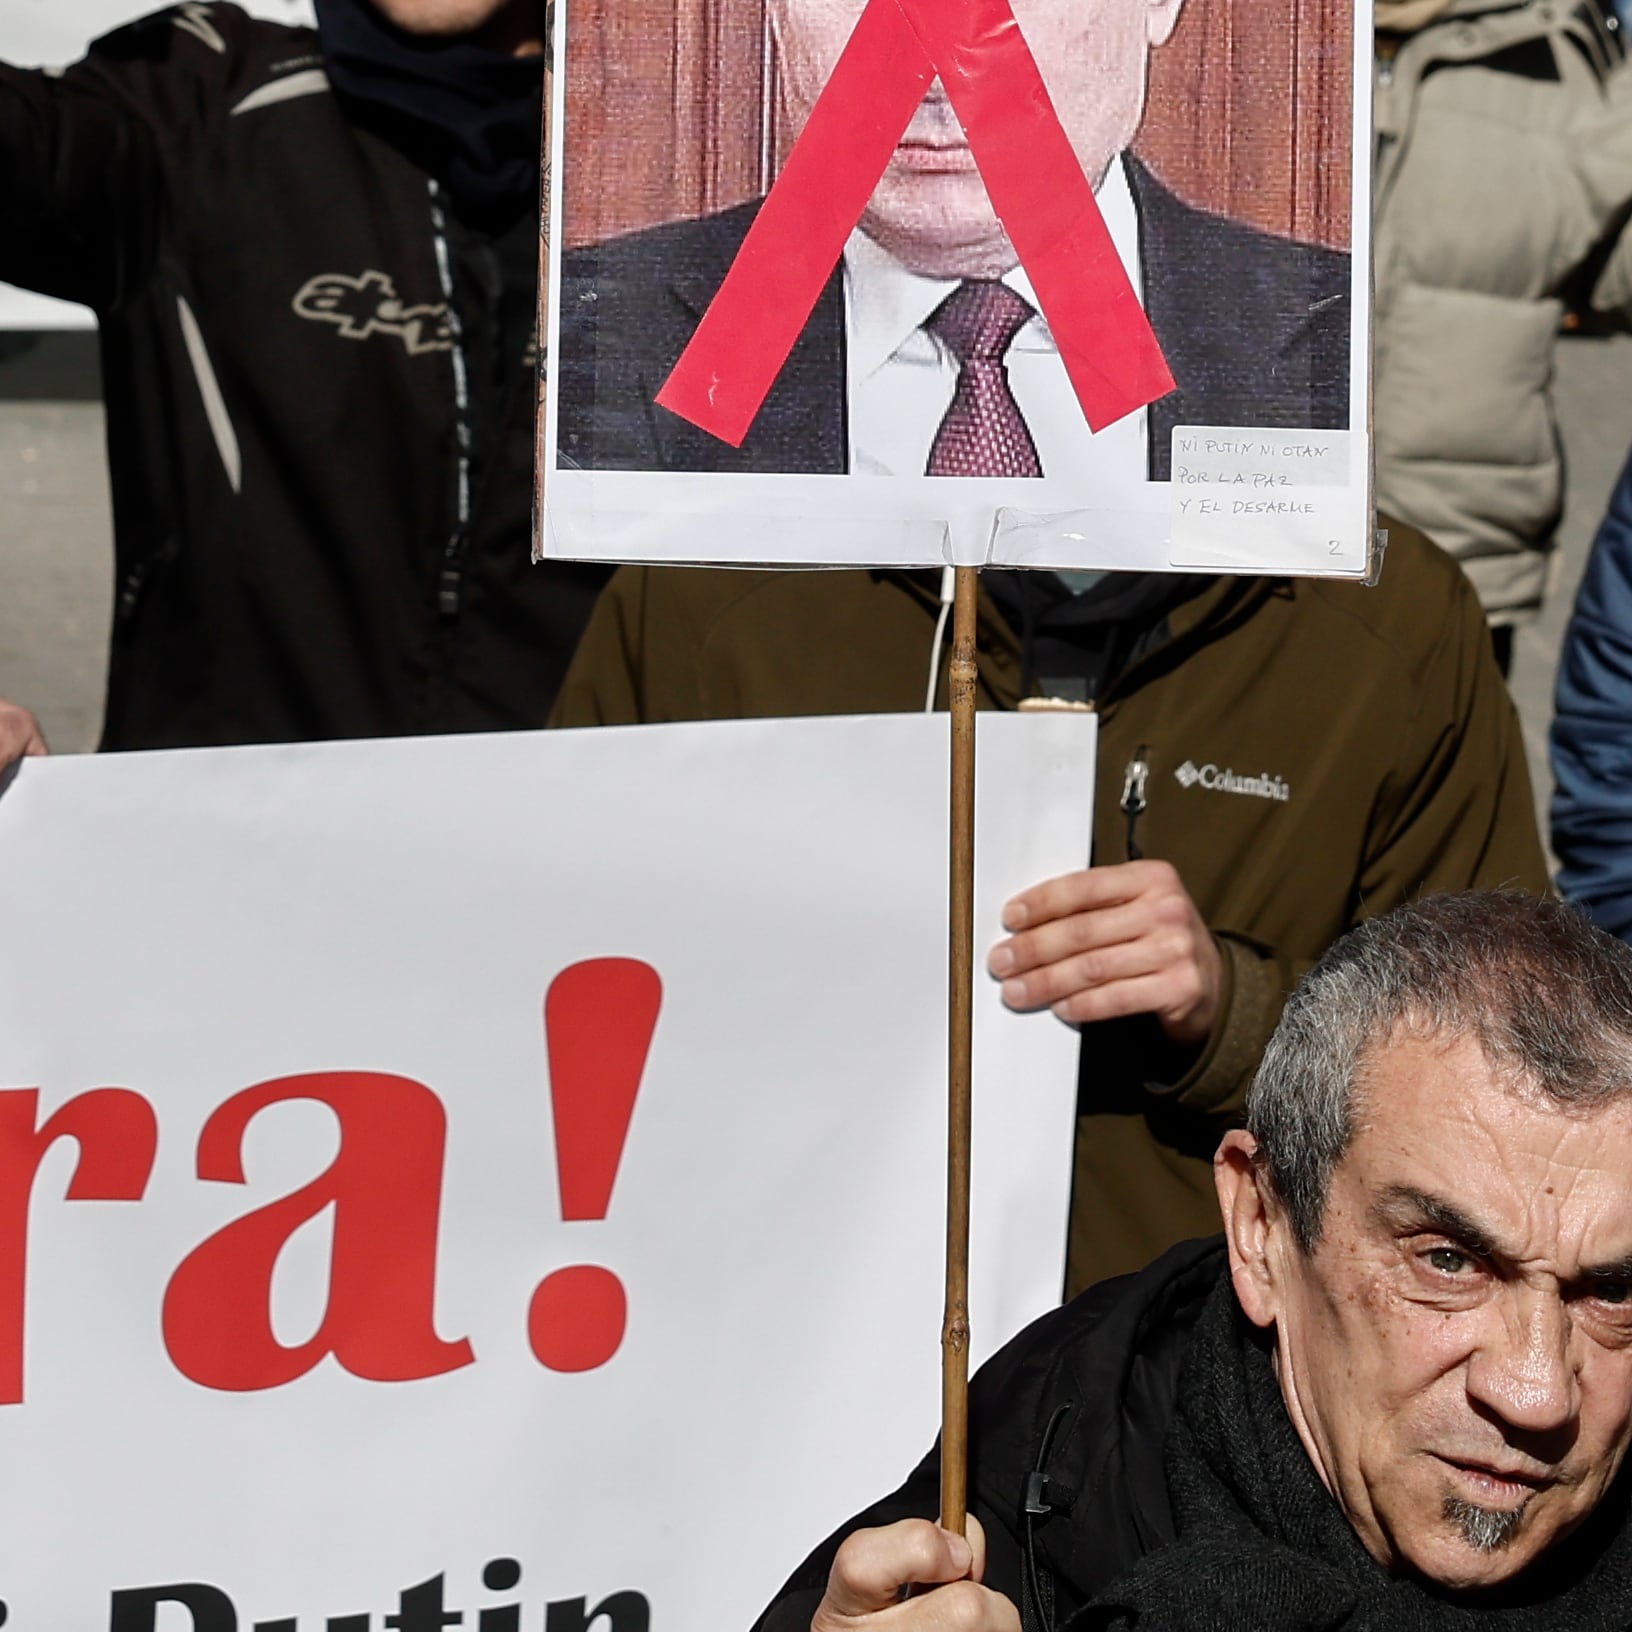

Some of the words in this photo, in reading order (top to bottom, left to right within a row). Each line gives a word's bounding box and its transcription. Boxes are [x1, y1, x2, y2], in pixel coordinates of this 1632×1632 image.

[1282, 445, 1328, 458] OTAN
[1178, 465, 1209, 485] POR
[1218, 472, 1246, 485] LA
[1180, 498, 1192, 514] Y
[1200, 498, 1223, 514] EL
[1232, 500, 1317, 514] DESARME
[1328, 539, 1344, 556] 2
[1199, 763, 1289, 801] Columbia
